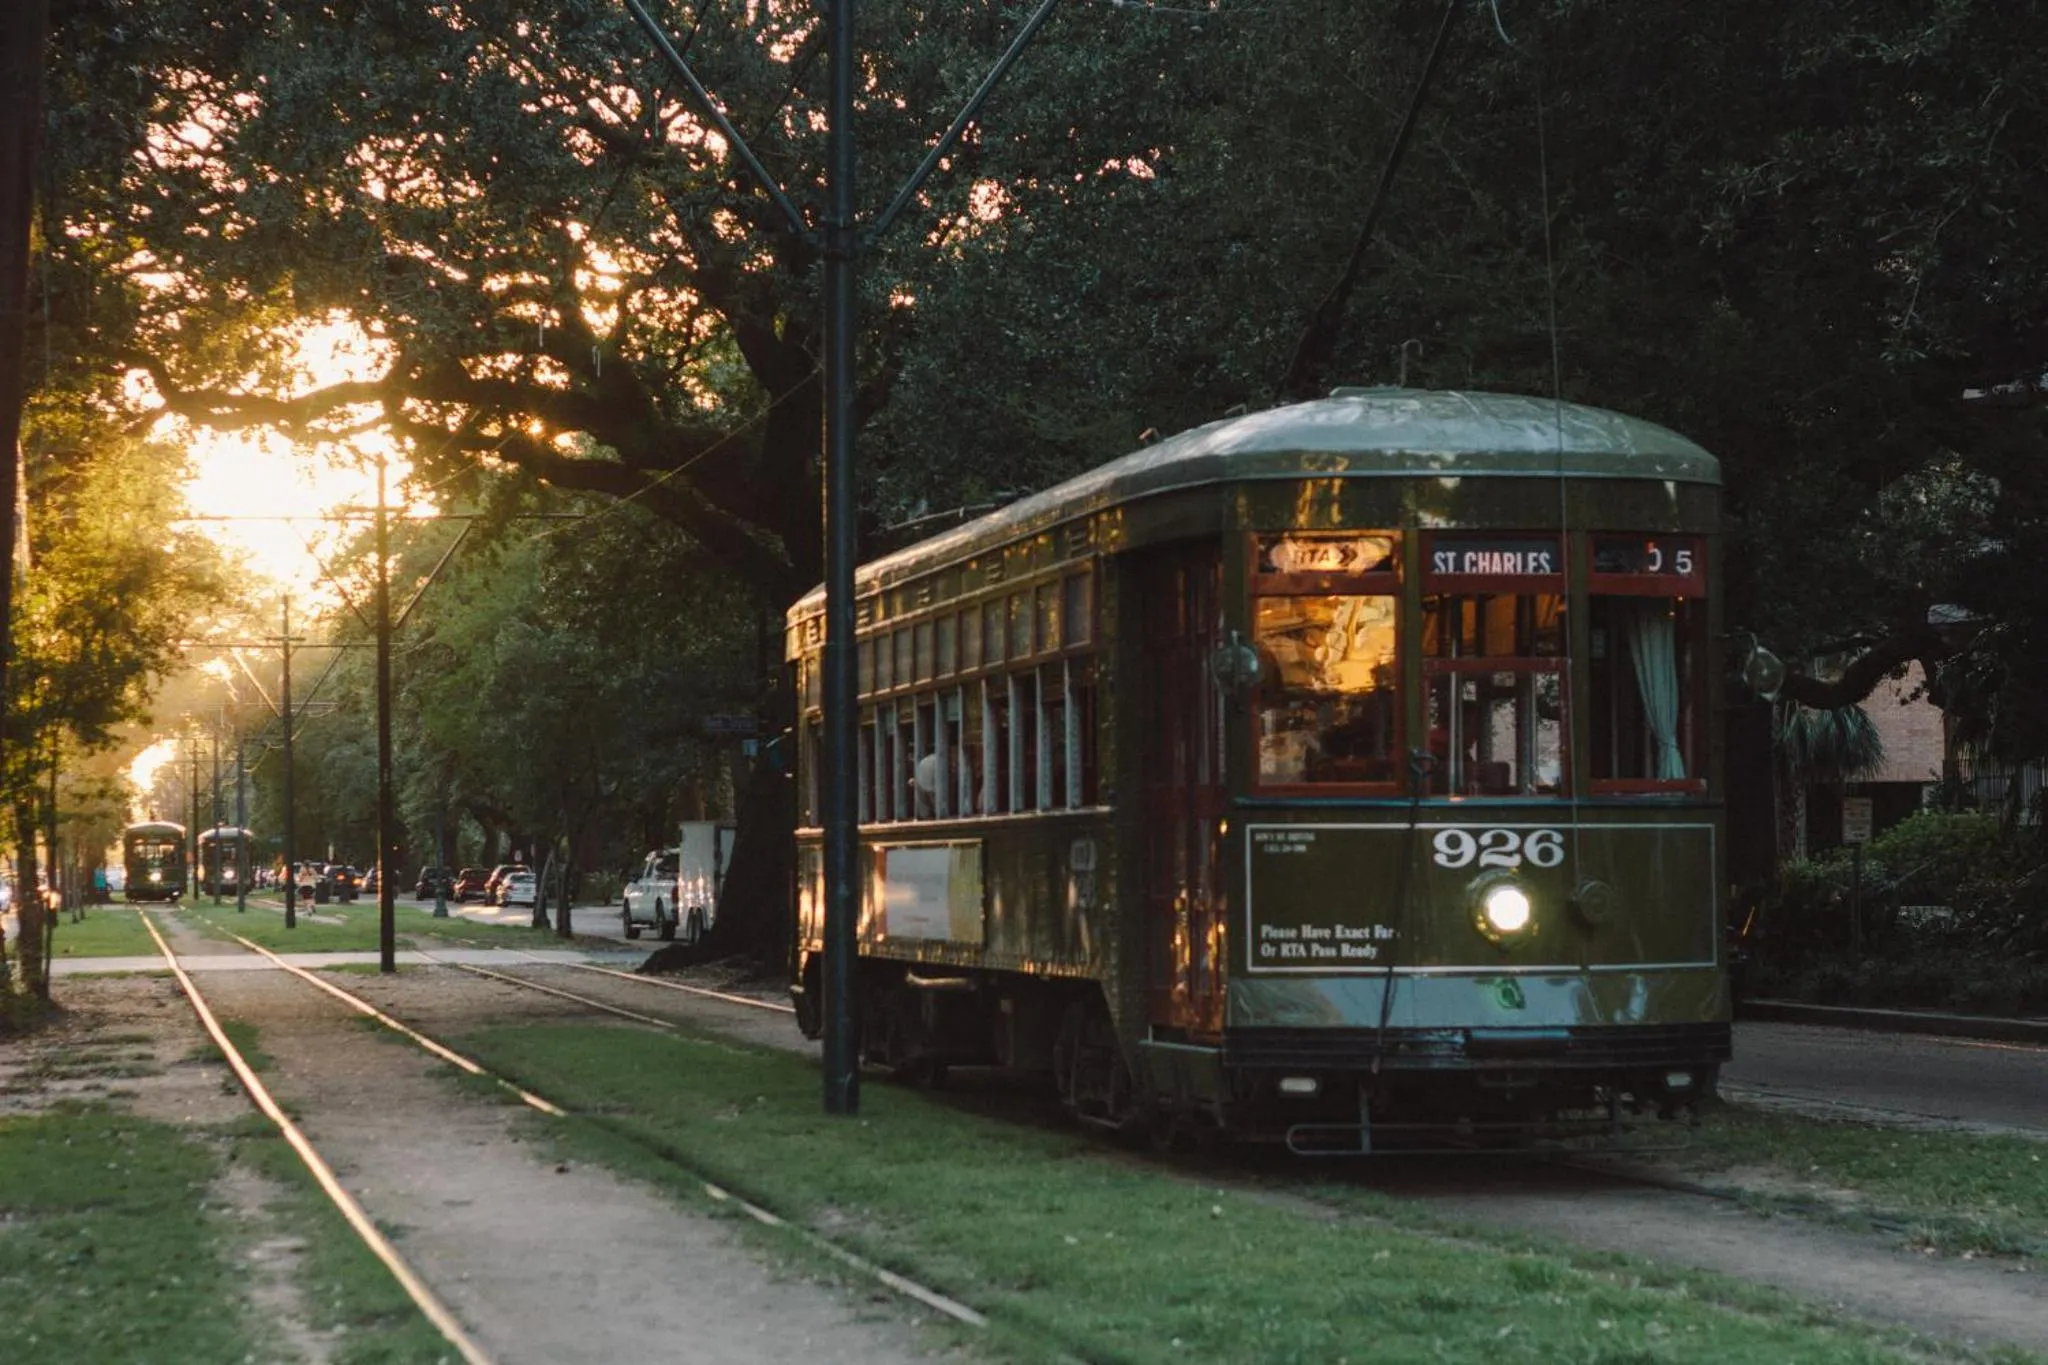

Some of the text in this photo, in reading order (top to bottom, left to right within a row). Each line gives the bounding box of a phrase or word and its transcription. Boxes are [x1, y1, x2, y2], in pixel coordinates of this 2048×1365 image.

[1464, 551, 1551, 574] CHARLES
[1433, 829, 1565, 868] 926
[1261, 924, 1399, 939] Please Have Exact Far
[1261, 943, 1377, 959] Or RTA Pass Ready
